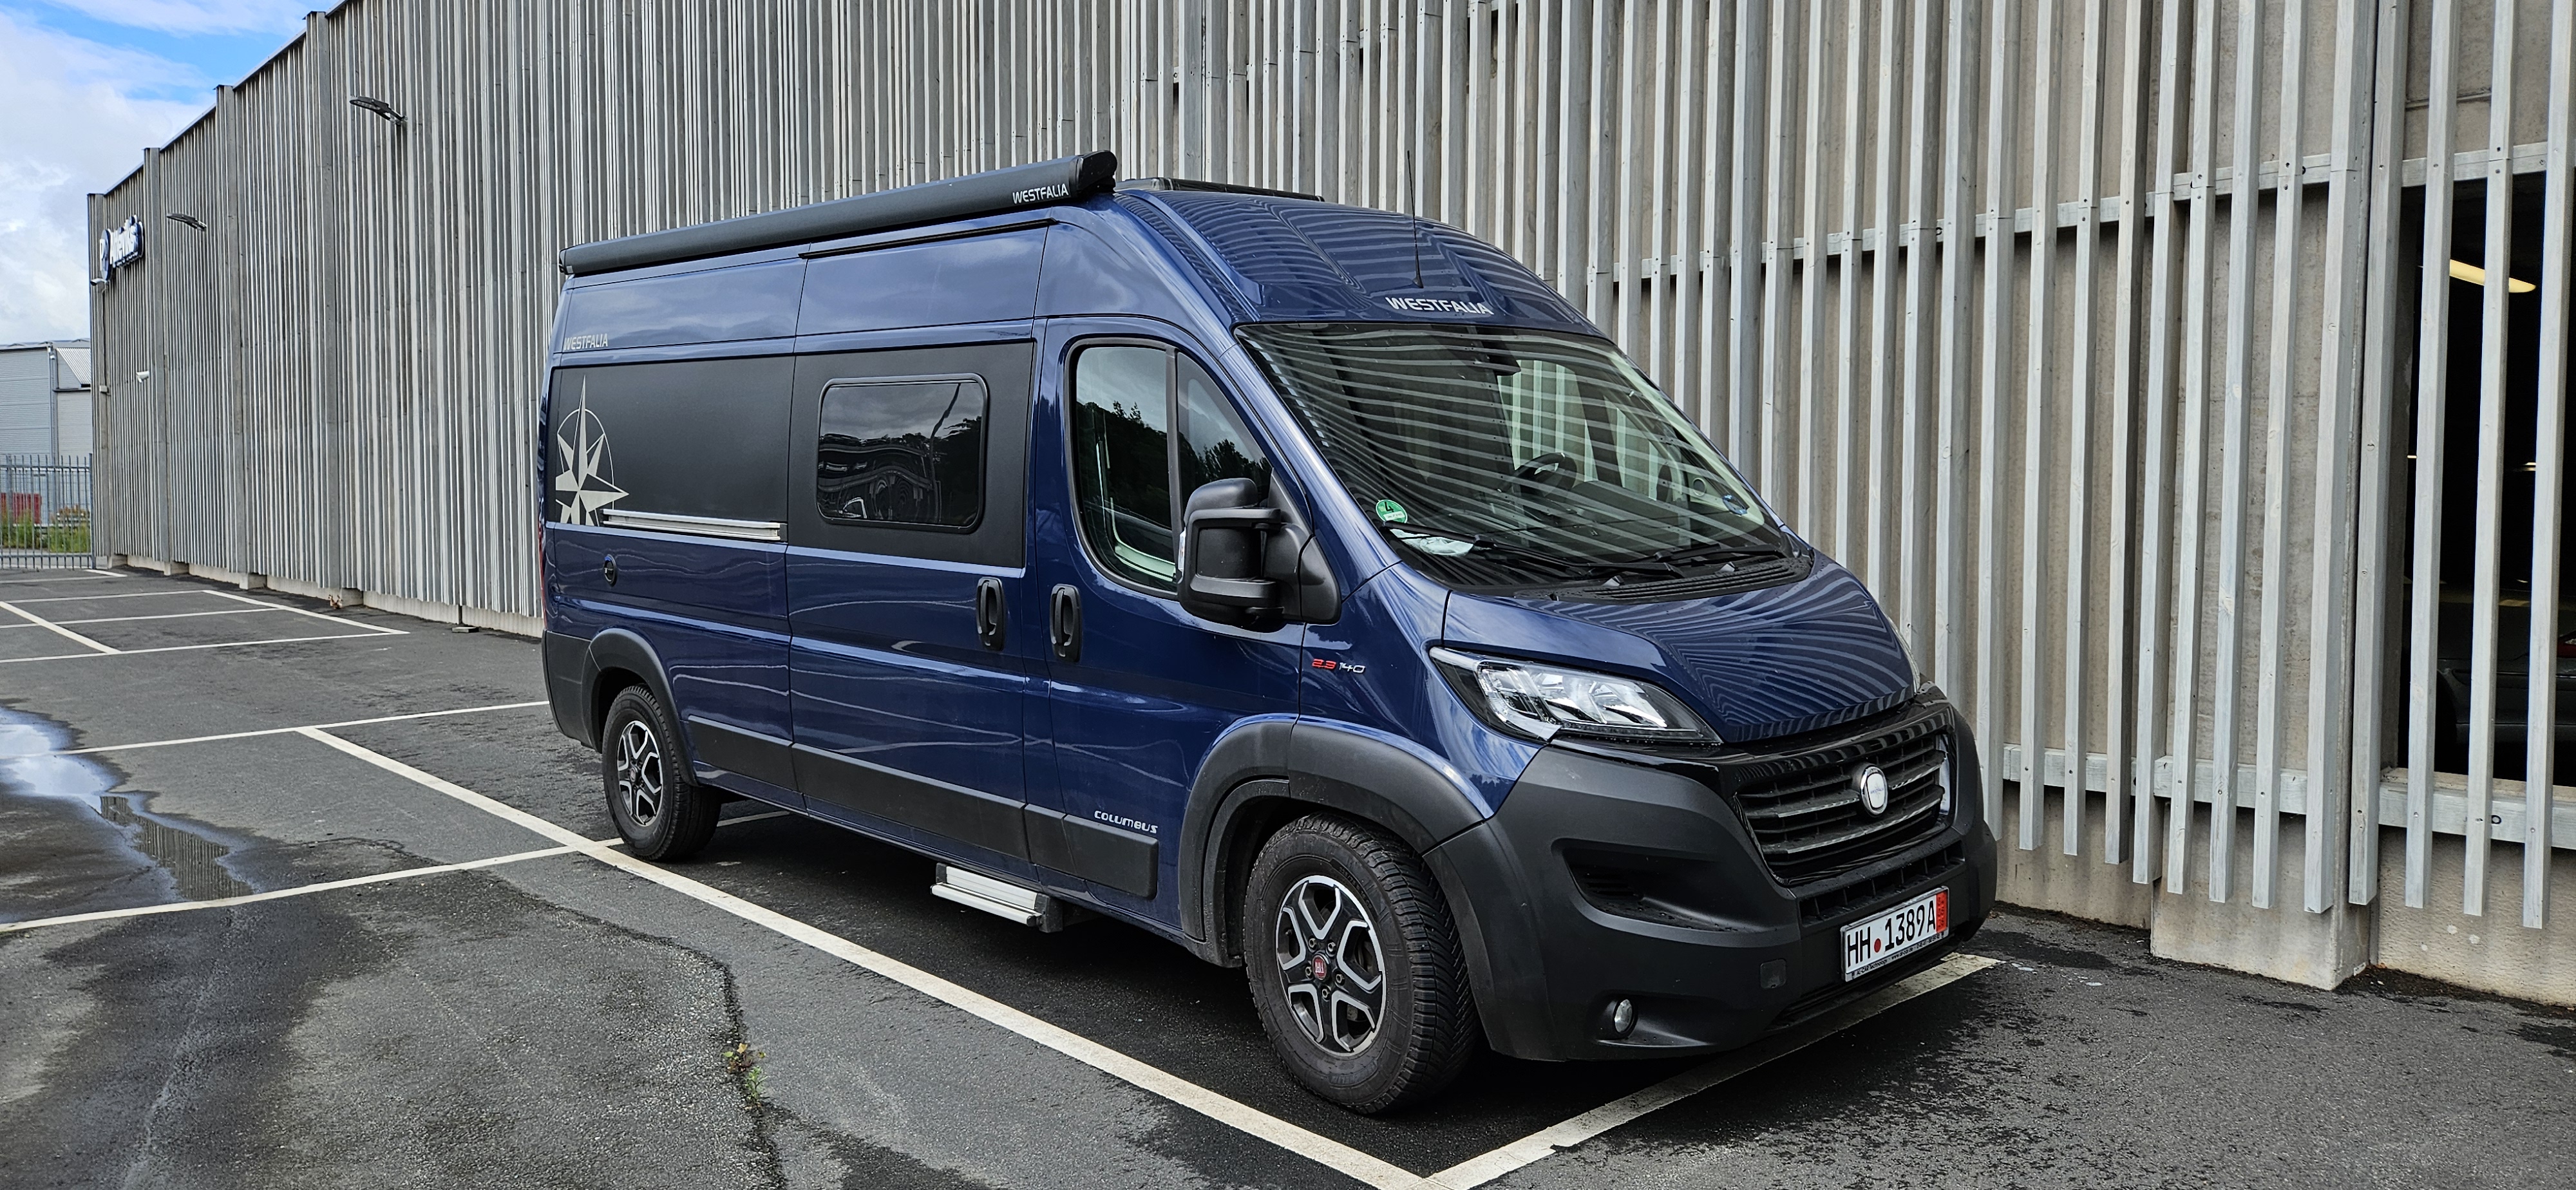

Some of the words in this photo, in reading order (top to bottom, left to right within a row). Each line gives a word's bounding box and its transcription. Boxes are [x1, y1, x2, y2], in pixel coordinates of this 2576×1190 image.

[1012, 183, 1069, 204] WESTFALIA
[1385, 297, 1494, 315] WESTFALIA
[564, 333, 608, 351] WESTFALIA
[1384, 501, 1395, 513] 4
[1339, 662, 1365, 674] 140
[1094, 810, 1158, 834] COLUMBUS
[1847, 926, 1870, 968] HH
[1884, 900, 1936, 952] 1389A
